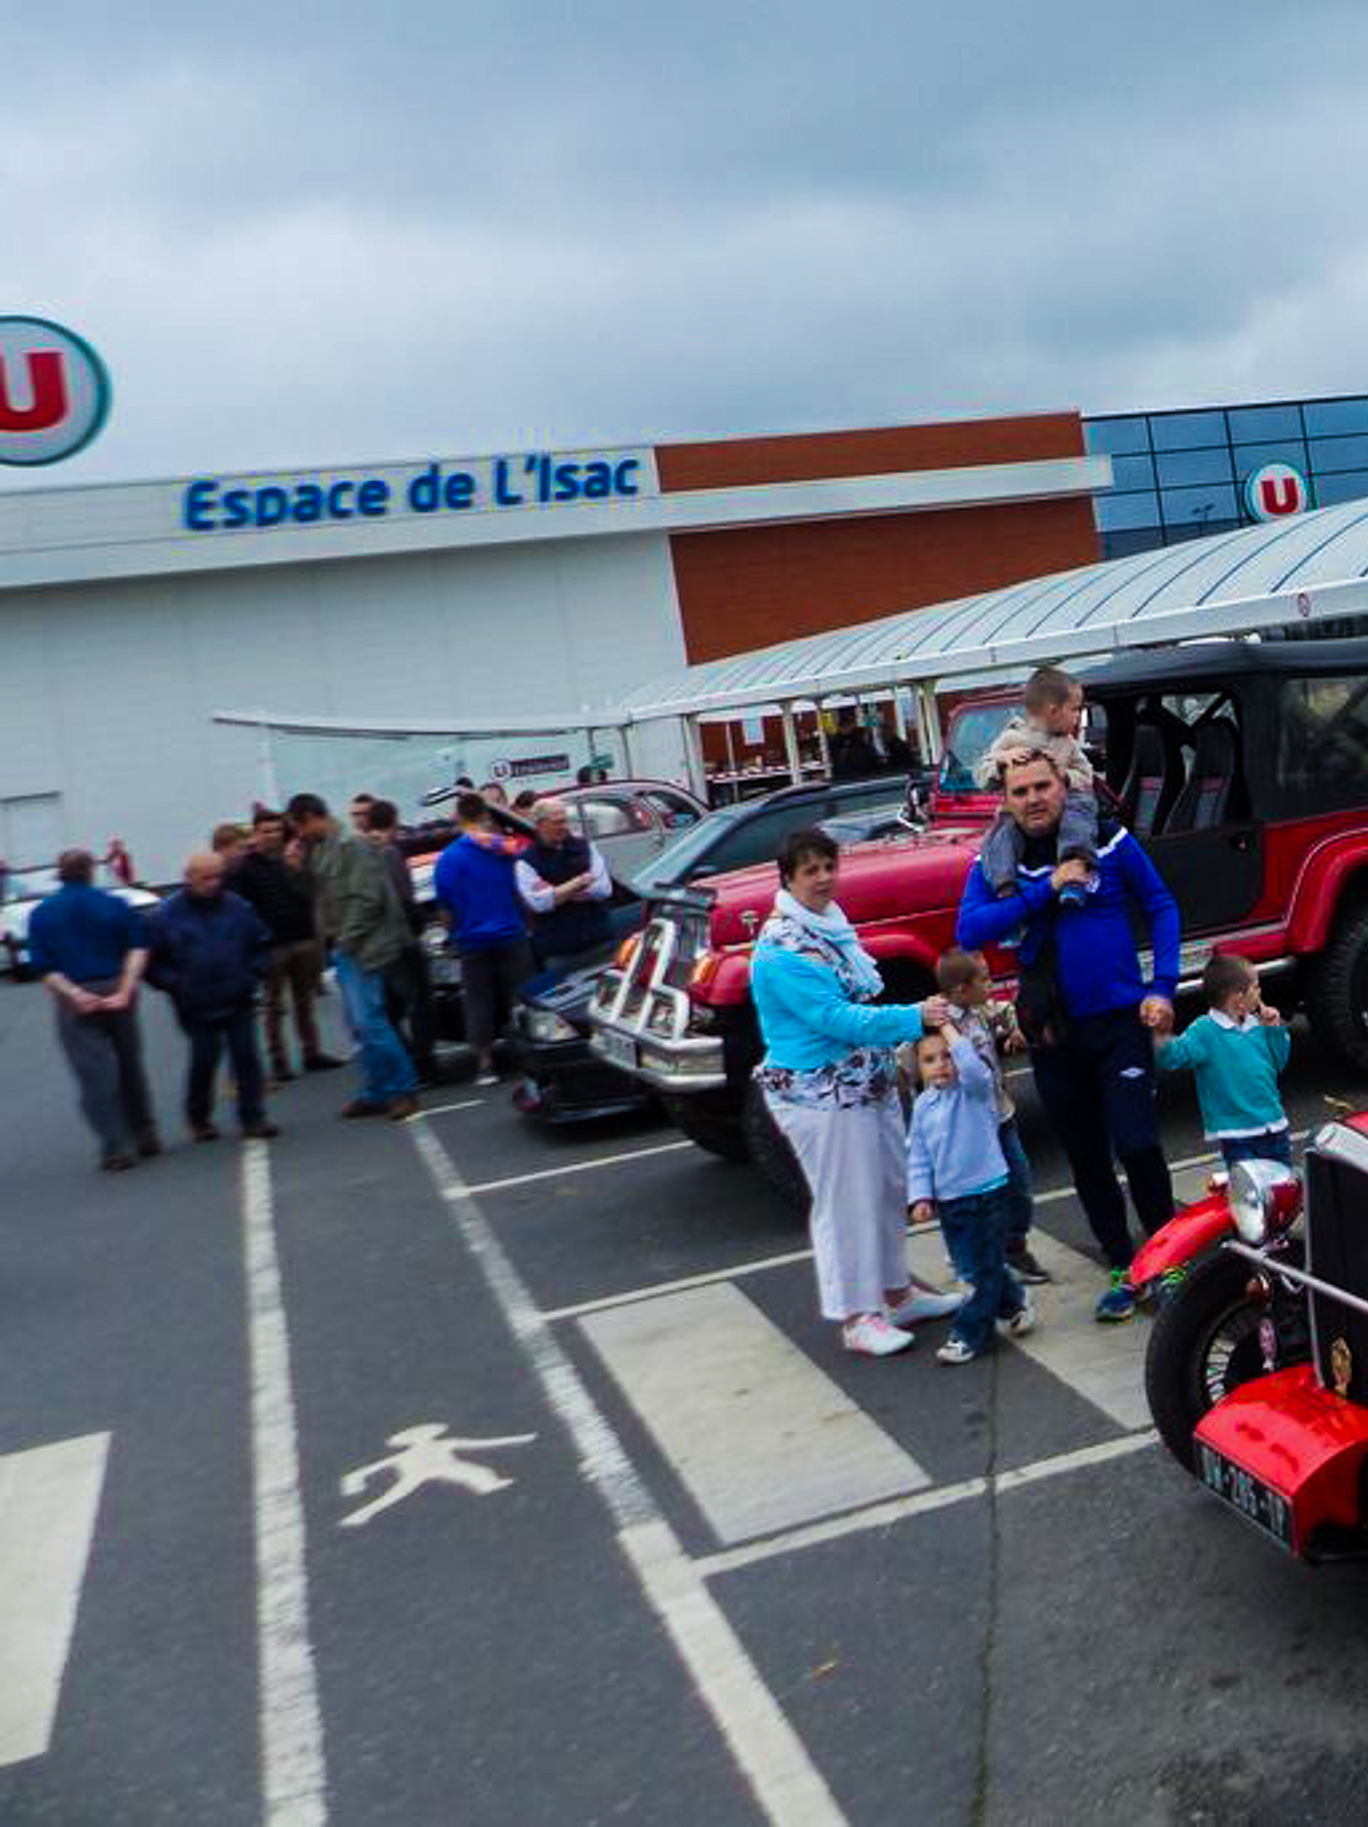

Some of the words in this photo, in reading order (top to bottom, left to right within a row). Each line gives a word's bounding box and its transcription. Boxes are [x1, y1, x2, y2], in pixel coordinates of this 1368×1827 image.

[0, 352, 66, 430] U
[186, 478, 389, 530] Espace
[409, 464, 474, 512] de
[497, 455, 639, 504] L'Isac
[1261, 478, 1298, 514] U
